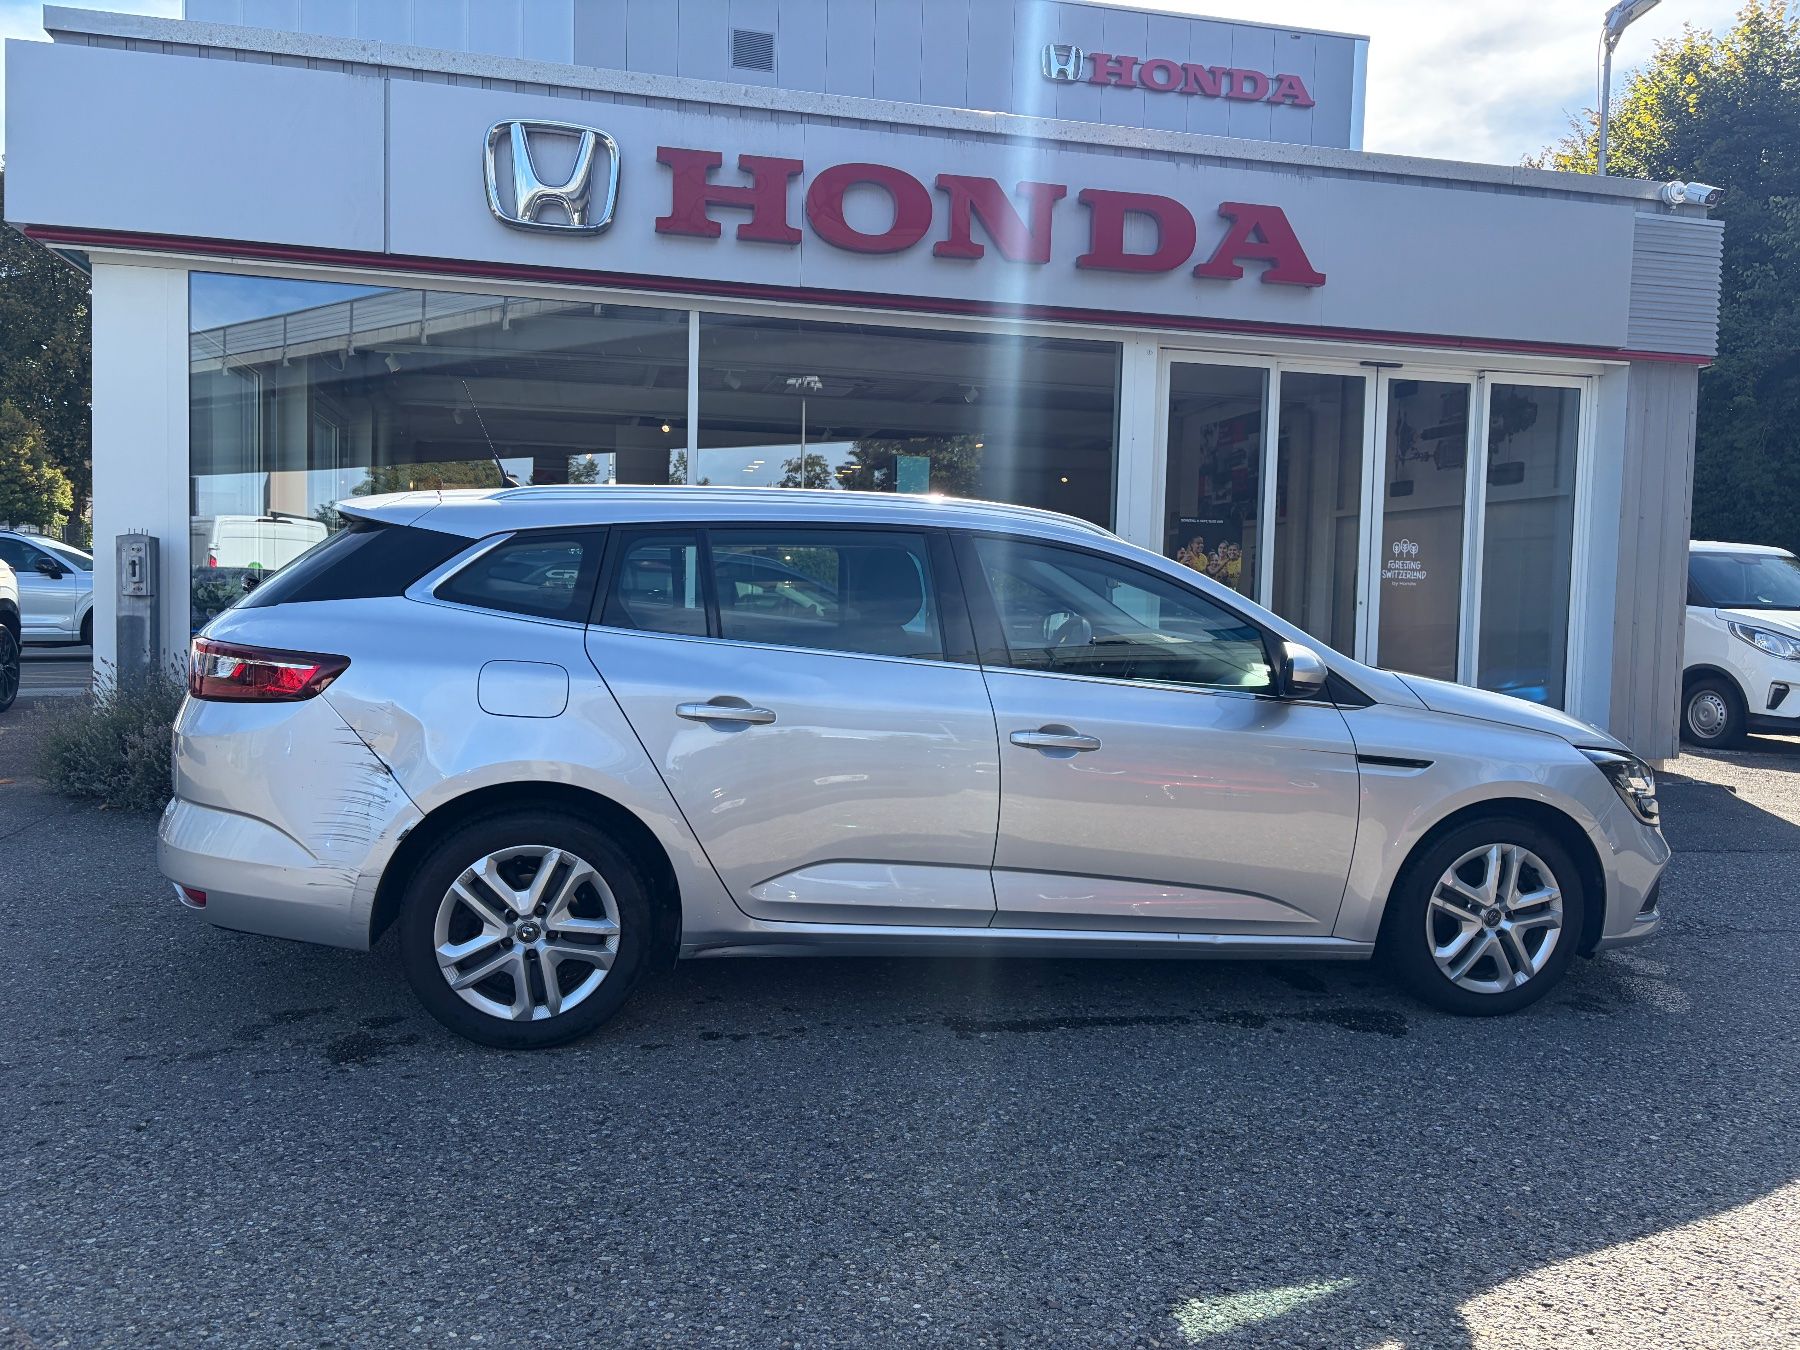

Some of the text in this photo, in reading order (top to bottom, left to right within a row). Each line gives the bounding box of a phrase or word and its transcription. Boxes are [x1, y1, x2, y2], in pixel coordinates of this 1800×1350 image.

[1088, 52, 1316, 107] HONDA
[655, 145, 1326, 287] HONDA
[1382, 570, 1427, 580] SWITZERLAND
